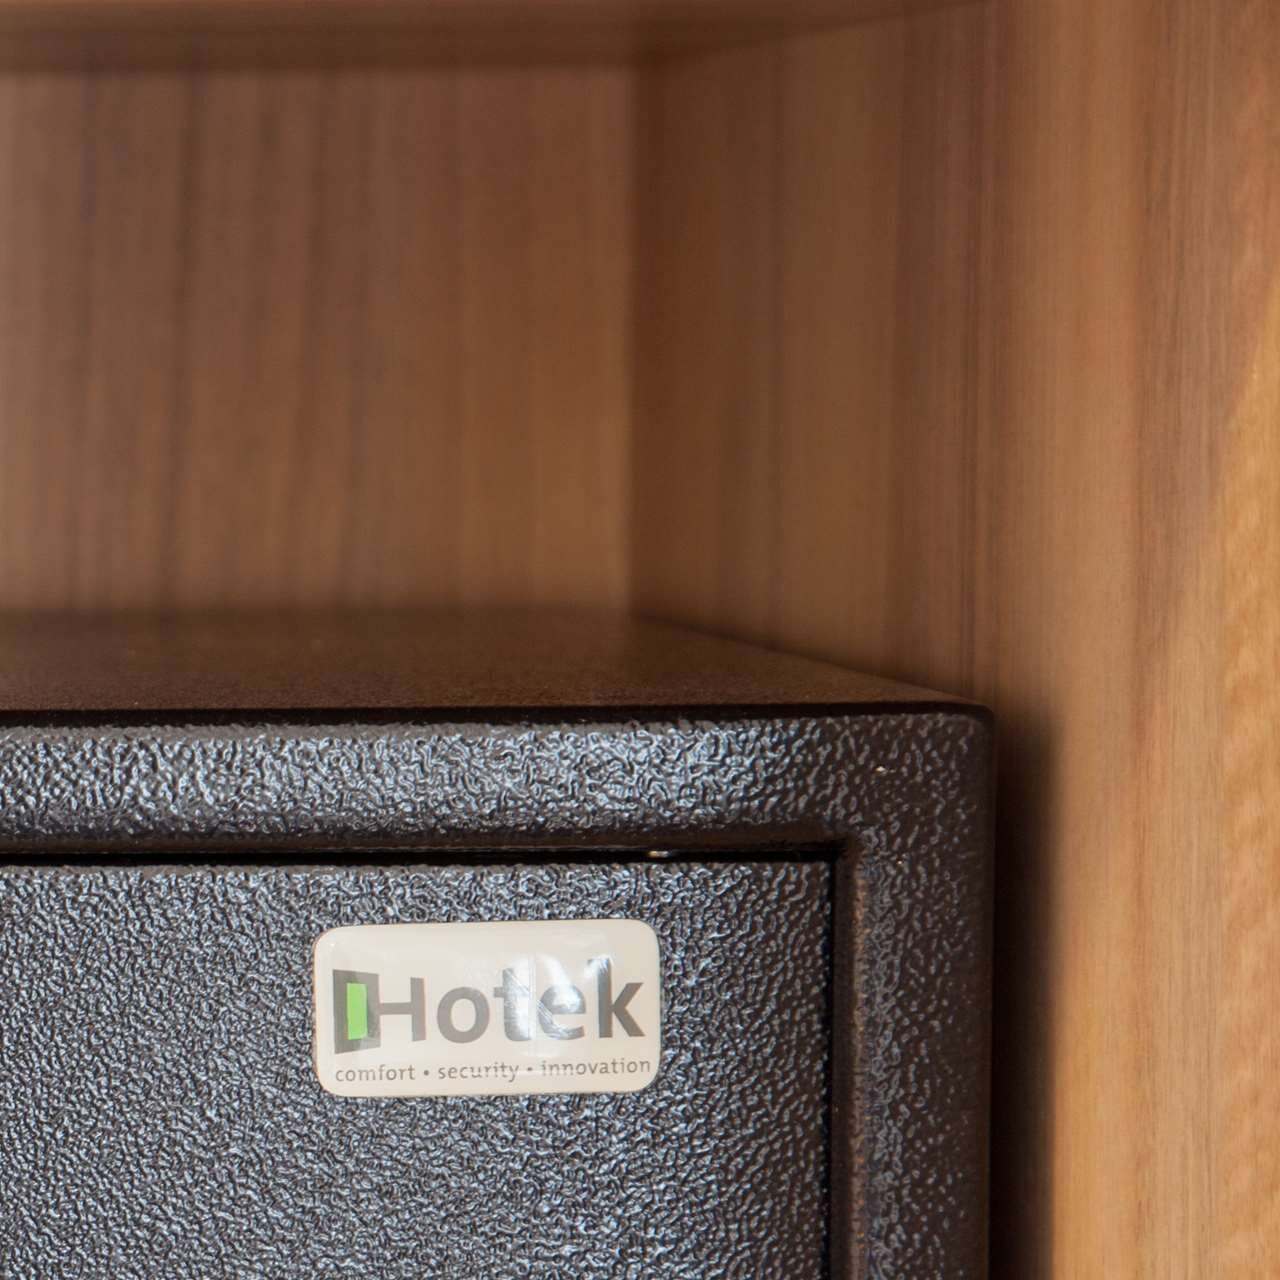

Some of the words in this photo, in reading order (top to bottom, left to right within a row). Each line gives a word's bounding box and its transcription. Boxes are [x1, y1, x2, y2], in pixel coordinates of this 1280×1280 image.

[332, 955, 646, 1055] Hotek
[334, 1063, 416, 1082] comfort
[437, 1061, 520, 1083] security
[540, 1057, 651, 1077] innovation
